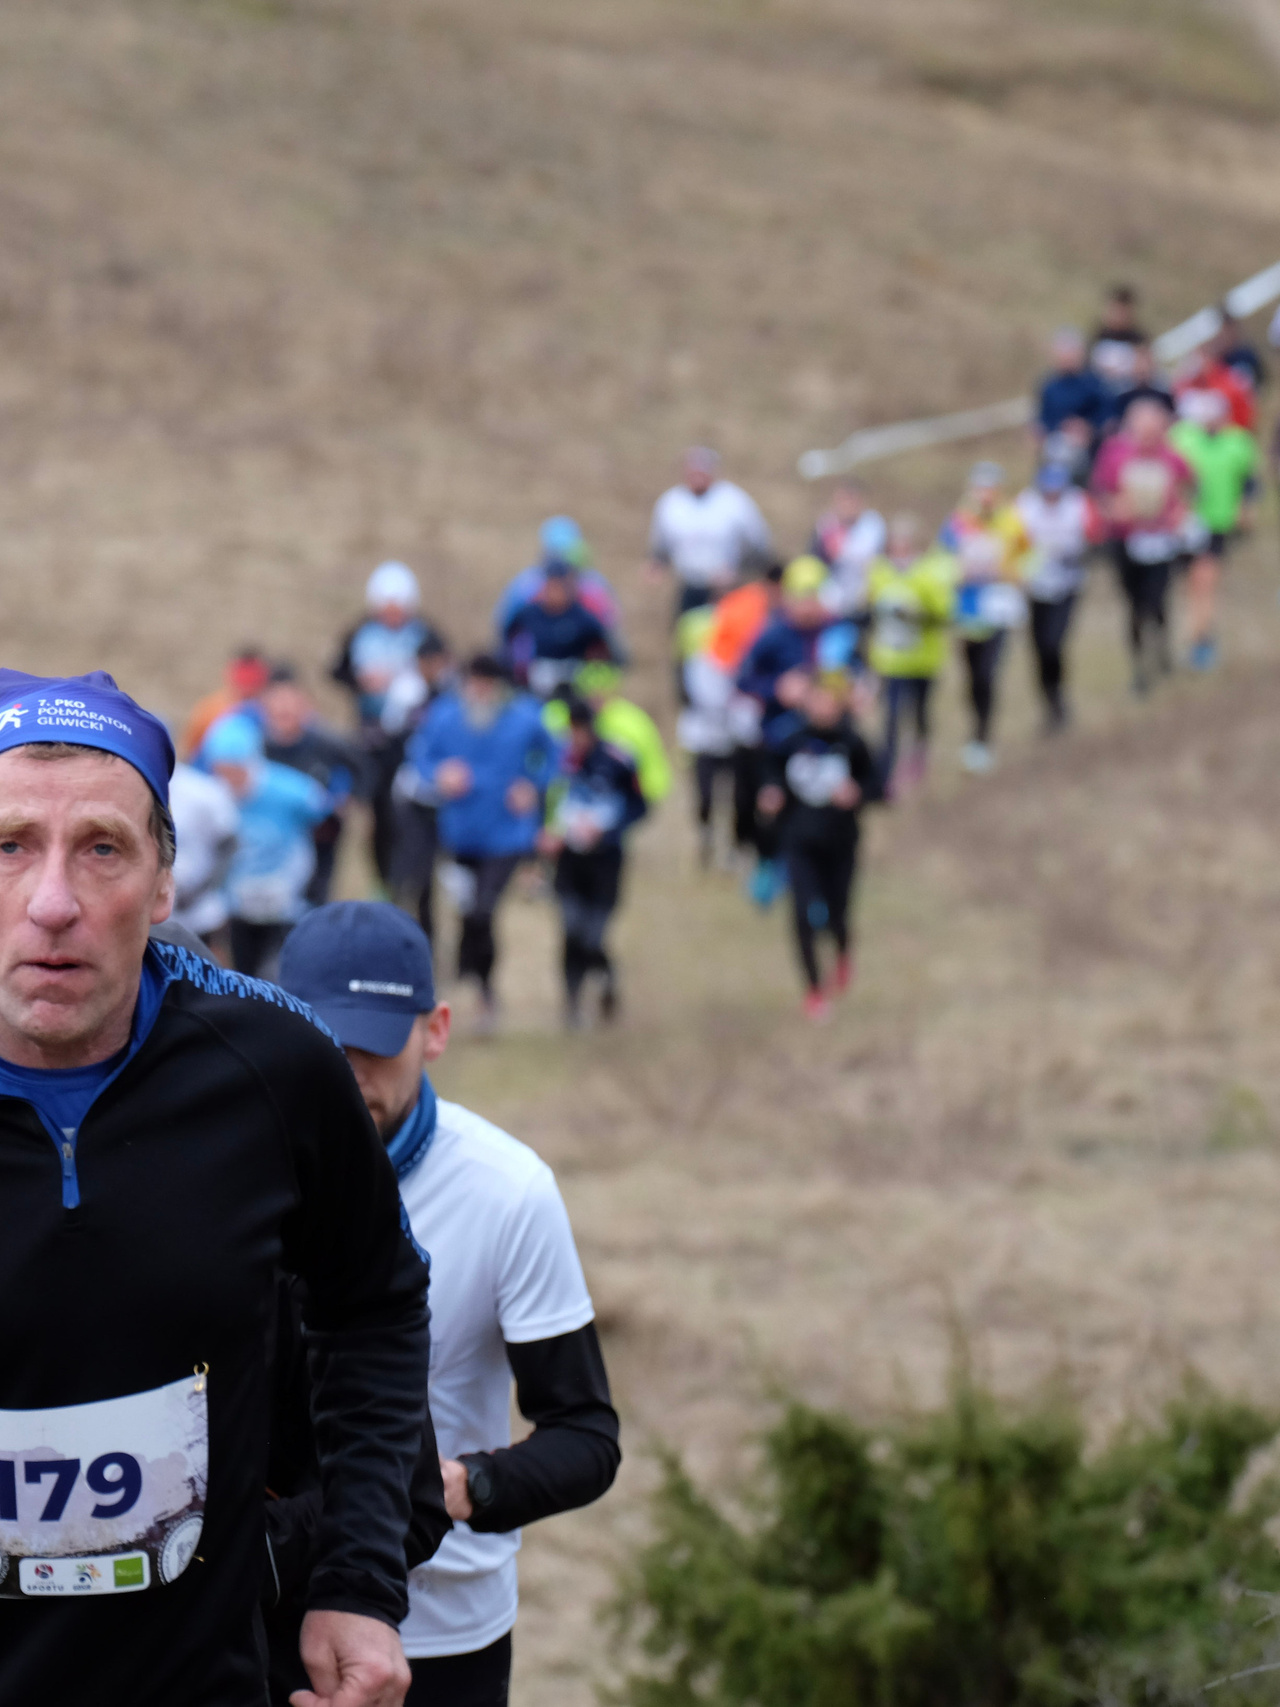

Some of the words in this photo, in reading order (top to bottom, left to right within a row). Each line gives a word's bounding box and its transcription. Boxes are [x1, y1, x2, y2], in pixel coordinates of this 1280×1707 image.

[55, 699, 85, 709] PKO
[37, 707, 132, 736] PÓŁMARATON
[37, 716, 104, 732] GLIWICKI
[27, 1583, 64, 1592] SPORTU
